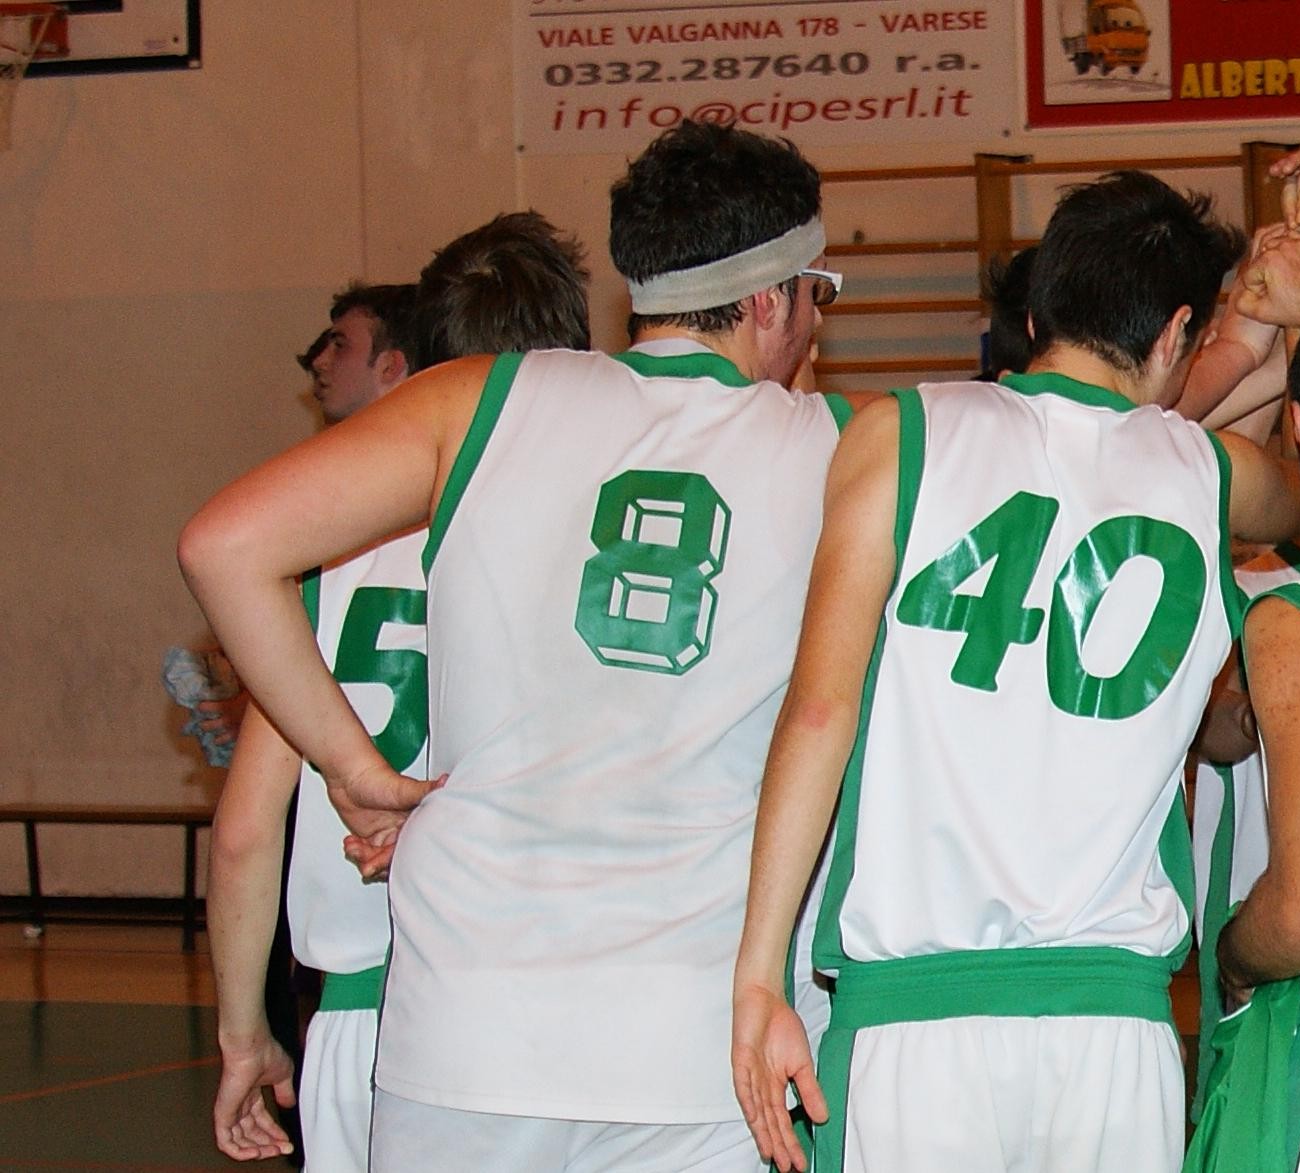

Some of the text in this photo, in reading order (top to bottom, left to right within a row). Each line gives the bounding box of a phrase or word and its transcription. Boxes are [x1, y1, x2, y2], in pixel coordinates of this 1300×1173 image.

[538, 27, 614, 48] VIALE
[627, 20, 783, 45] VALGANNA
[796, 17, 839, 37] 178
[880, 10, 988, 33] VARESE
[544, 50, 981, 87] 0332.287640 r.a.
[552, 87, 974, 131] info@cipesrl.it
[575, 470, 732, 676] 8
[896, 490, 1207, 720] 40
